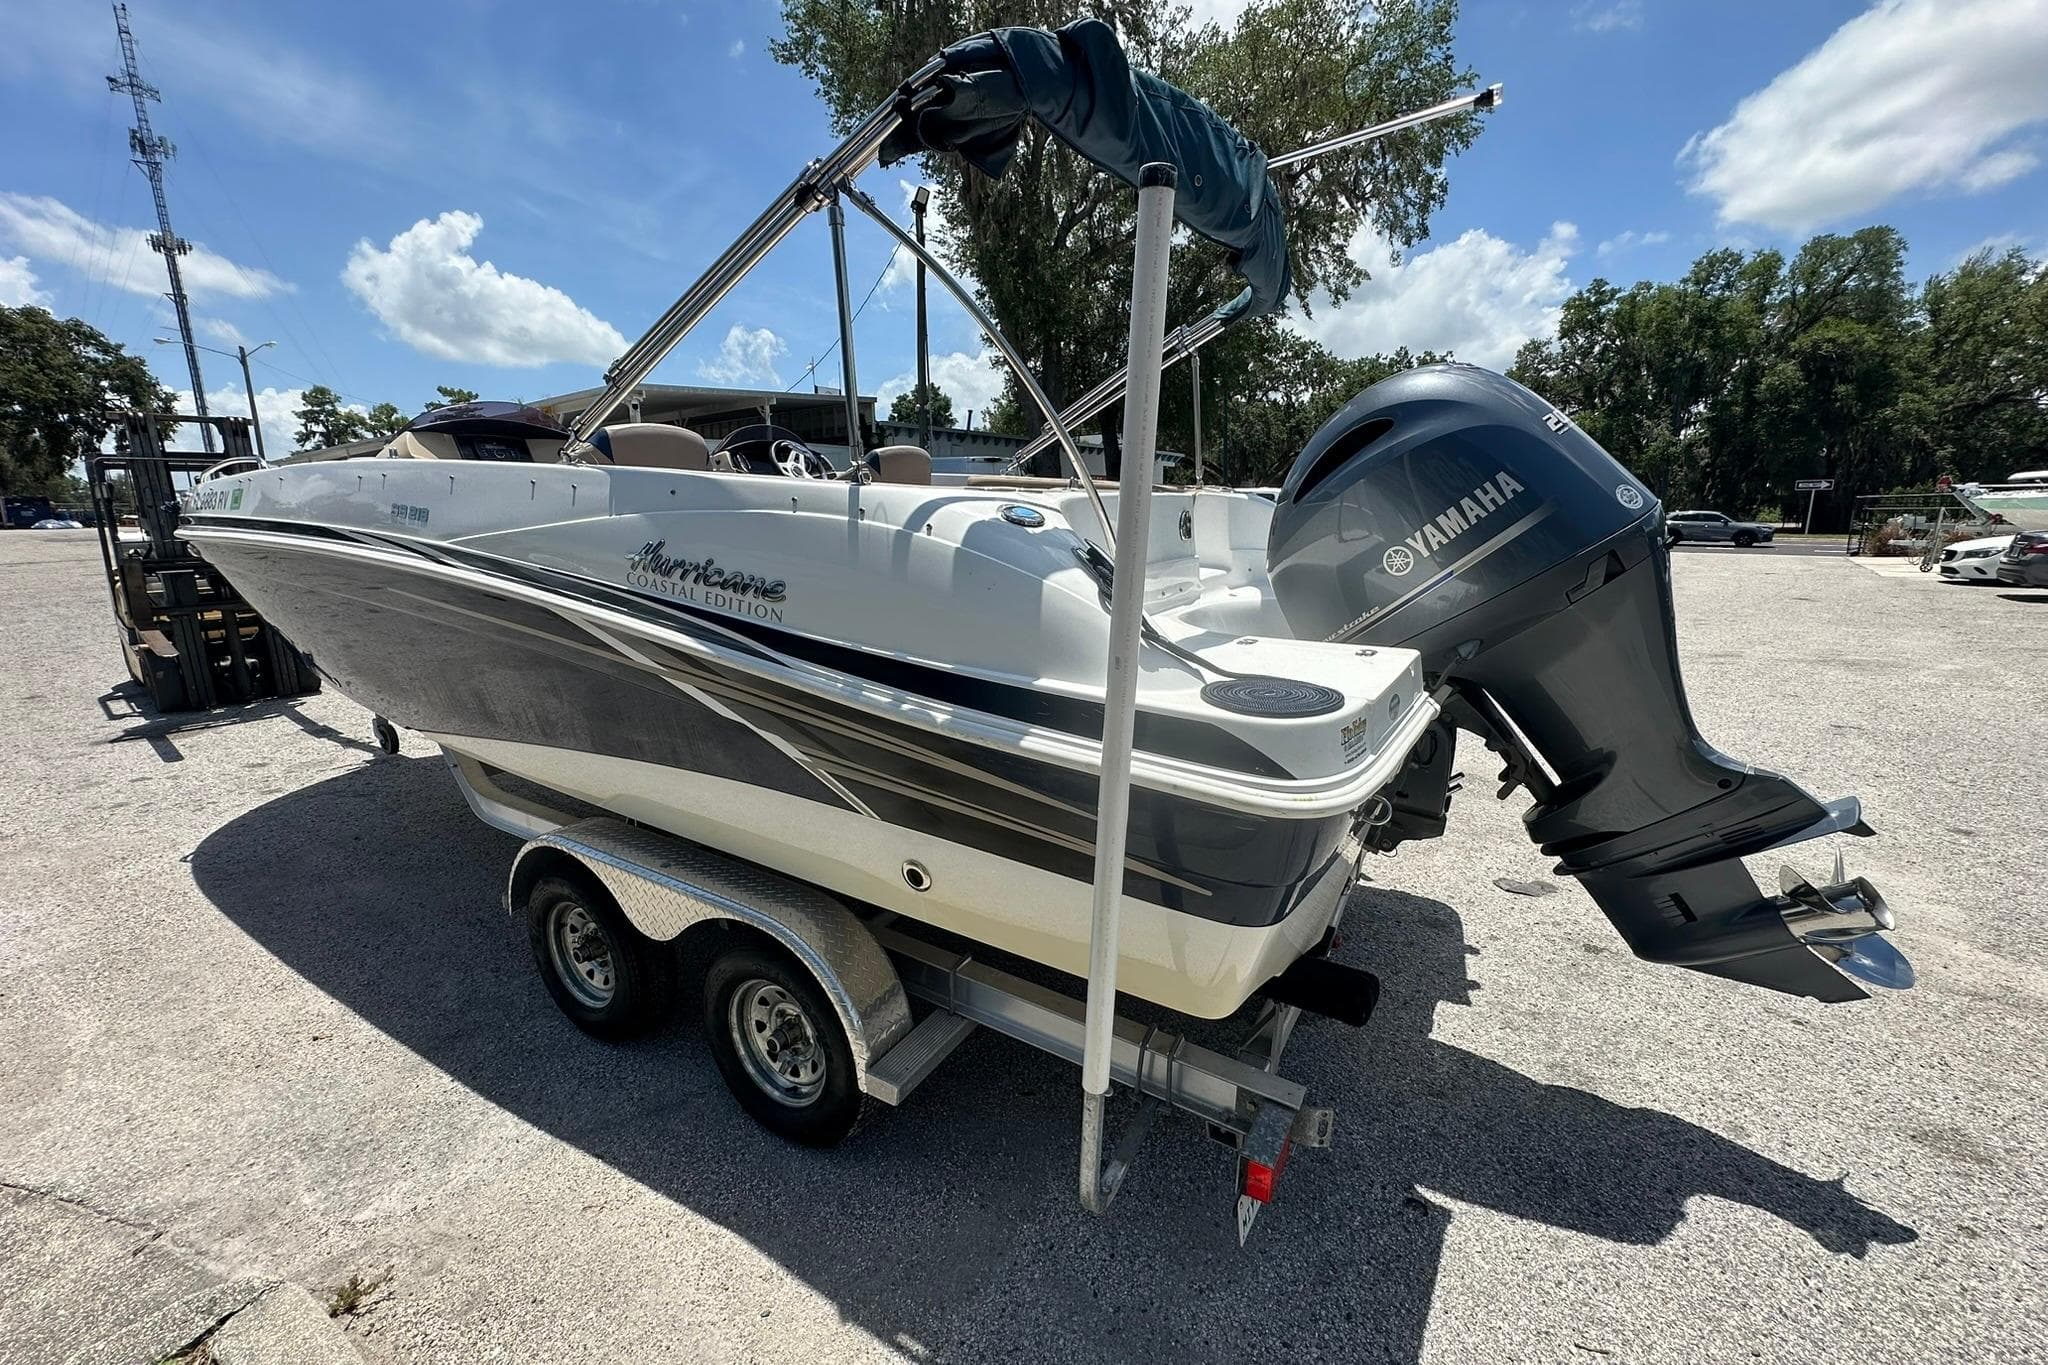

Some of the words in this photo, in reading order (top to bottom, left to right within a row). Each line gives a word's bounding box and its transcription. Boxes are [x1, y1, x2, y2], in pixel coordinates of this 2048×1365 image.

[1405, 471, 1525, 558] YAMAHA
[624, 539, 787, 603] Hurricane
[626, 571, 697, 602] COASTAL
[705, 591, 783, 624] EDITION
